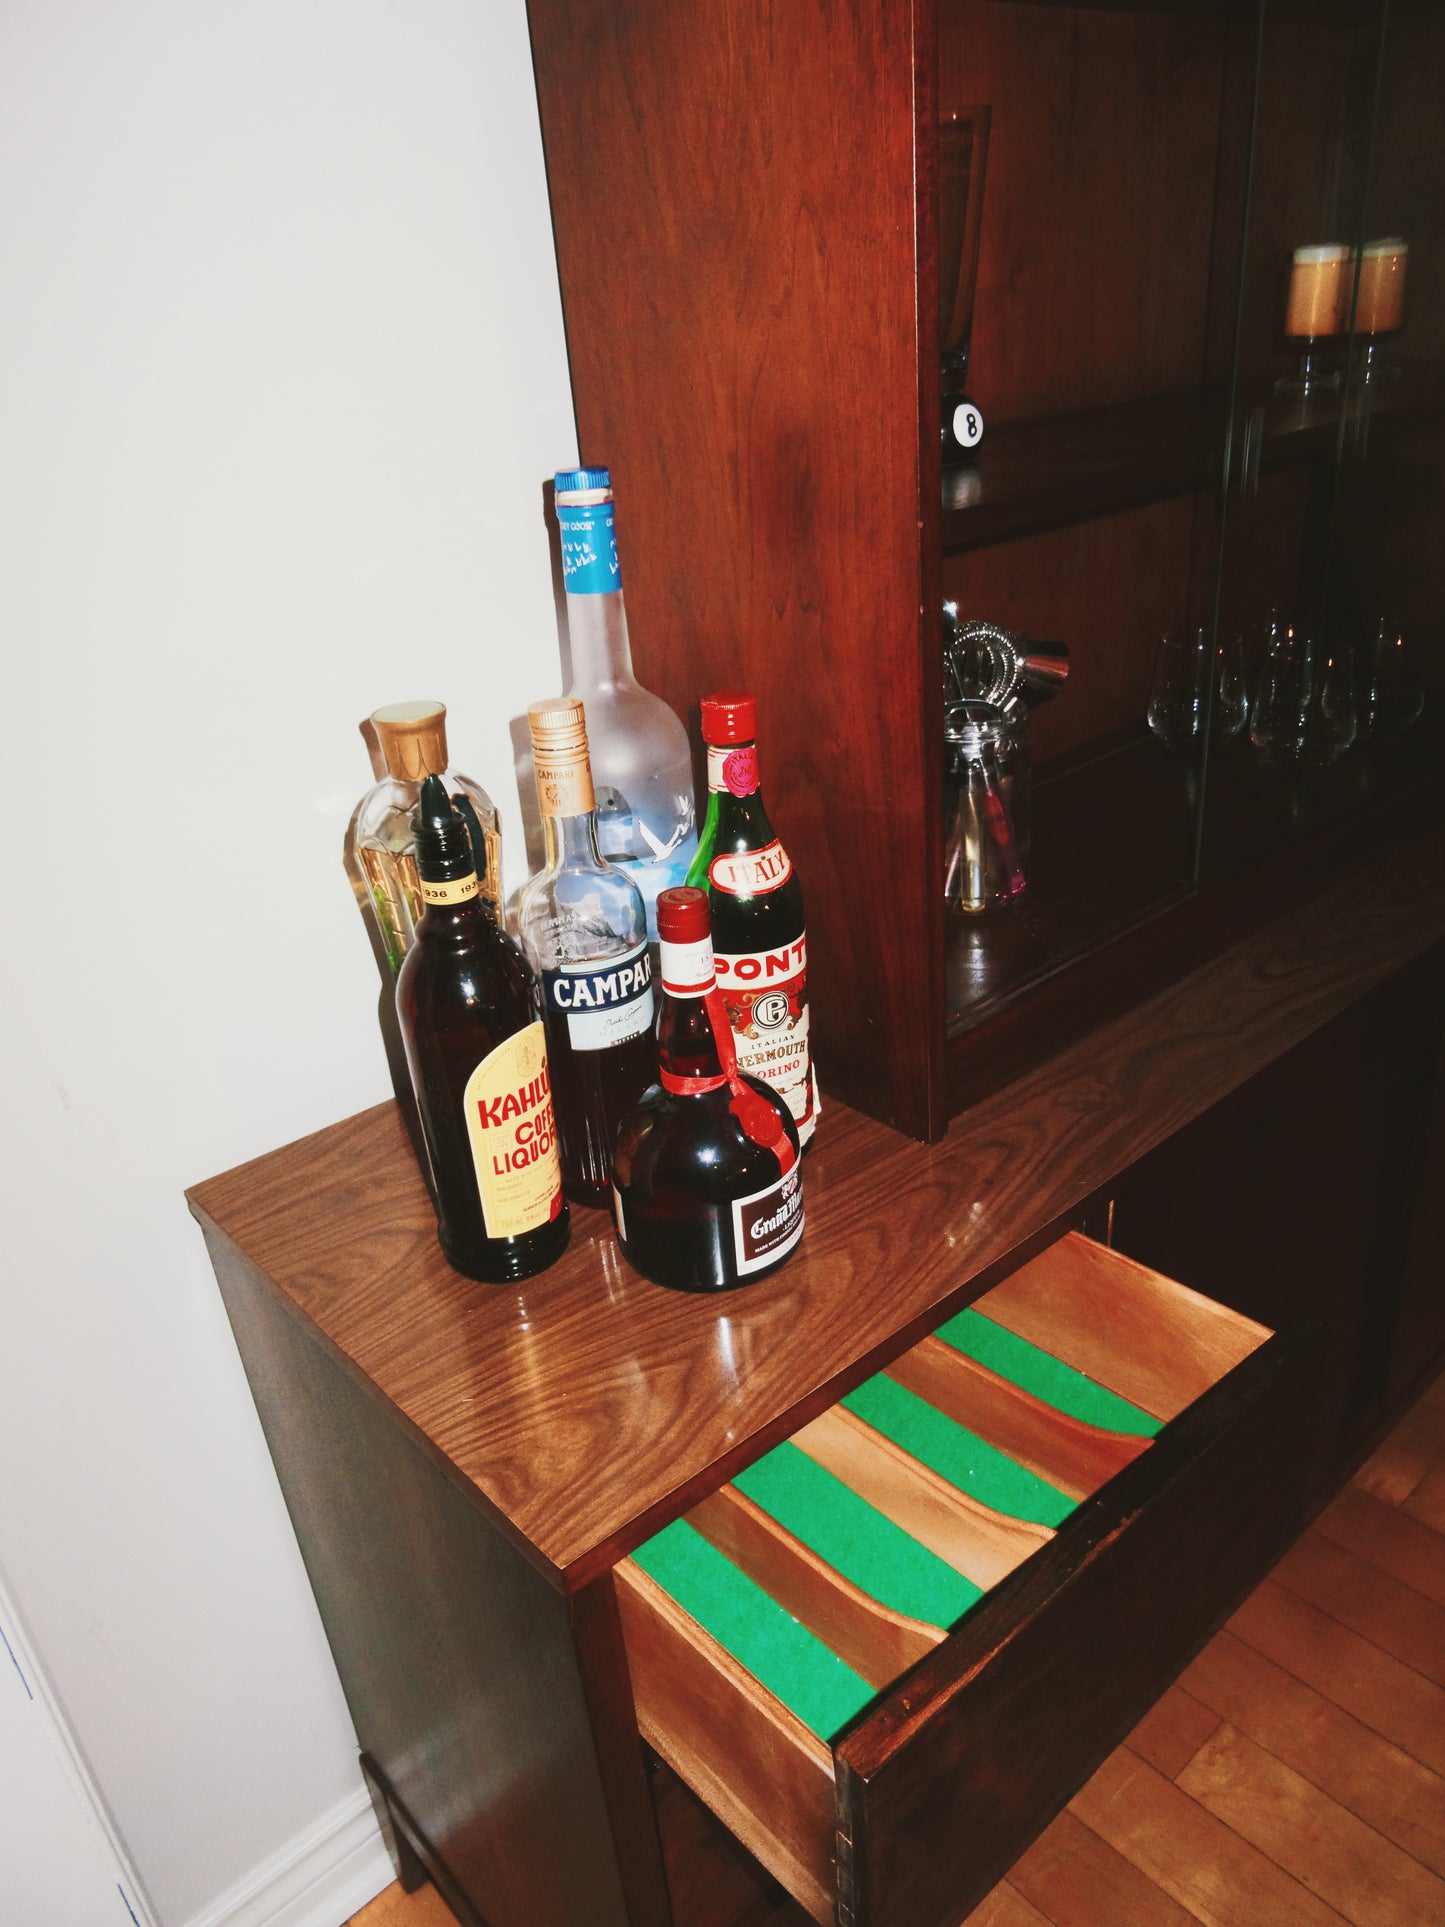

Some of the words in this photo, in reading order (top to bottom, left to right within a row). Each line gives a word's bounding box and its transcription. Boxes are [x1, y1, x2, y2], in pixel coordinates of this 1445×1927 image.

[966, 413, 977, 438] 8
[538, 768, 574, 780] CAMPARI
[728, 850, 785, 884] ITALY
[423, 889, 448, 898] 936
[461, 881, 477, 894] 193
[553, 952, 652, 1008] CAMPAR
[752, 1034, 795, 1050] ITALIAN
[758, 1060, 800, 1079] ORINO
[477, 1056, 551, 1129] KAHLÚ
[515, 1101, 555, 1145] COFF
